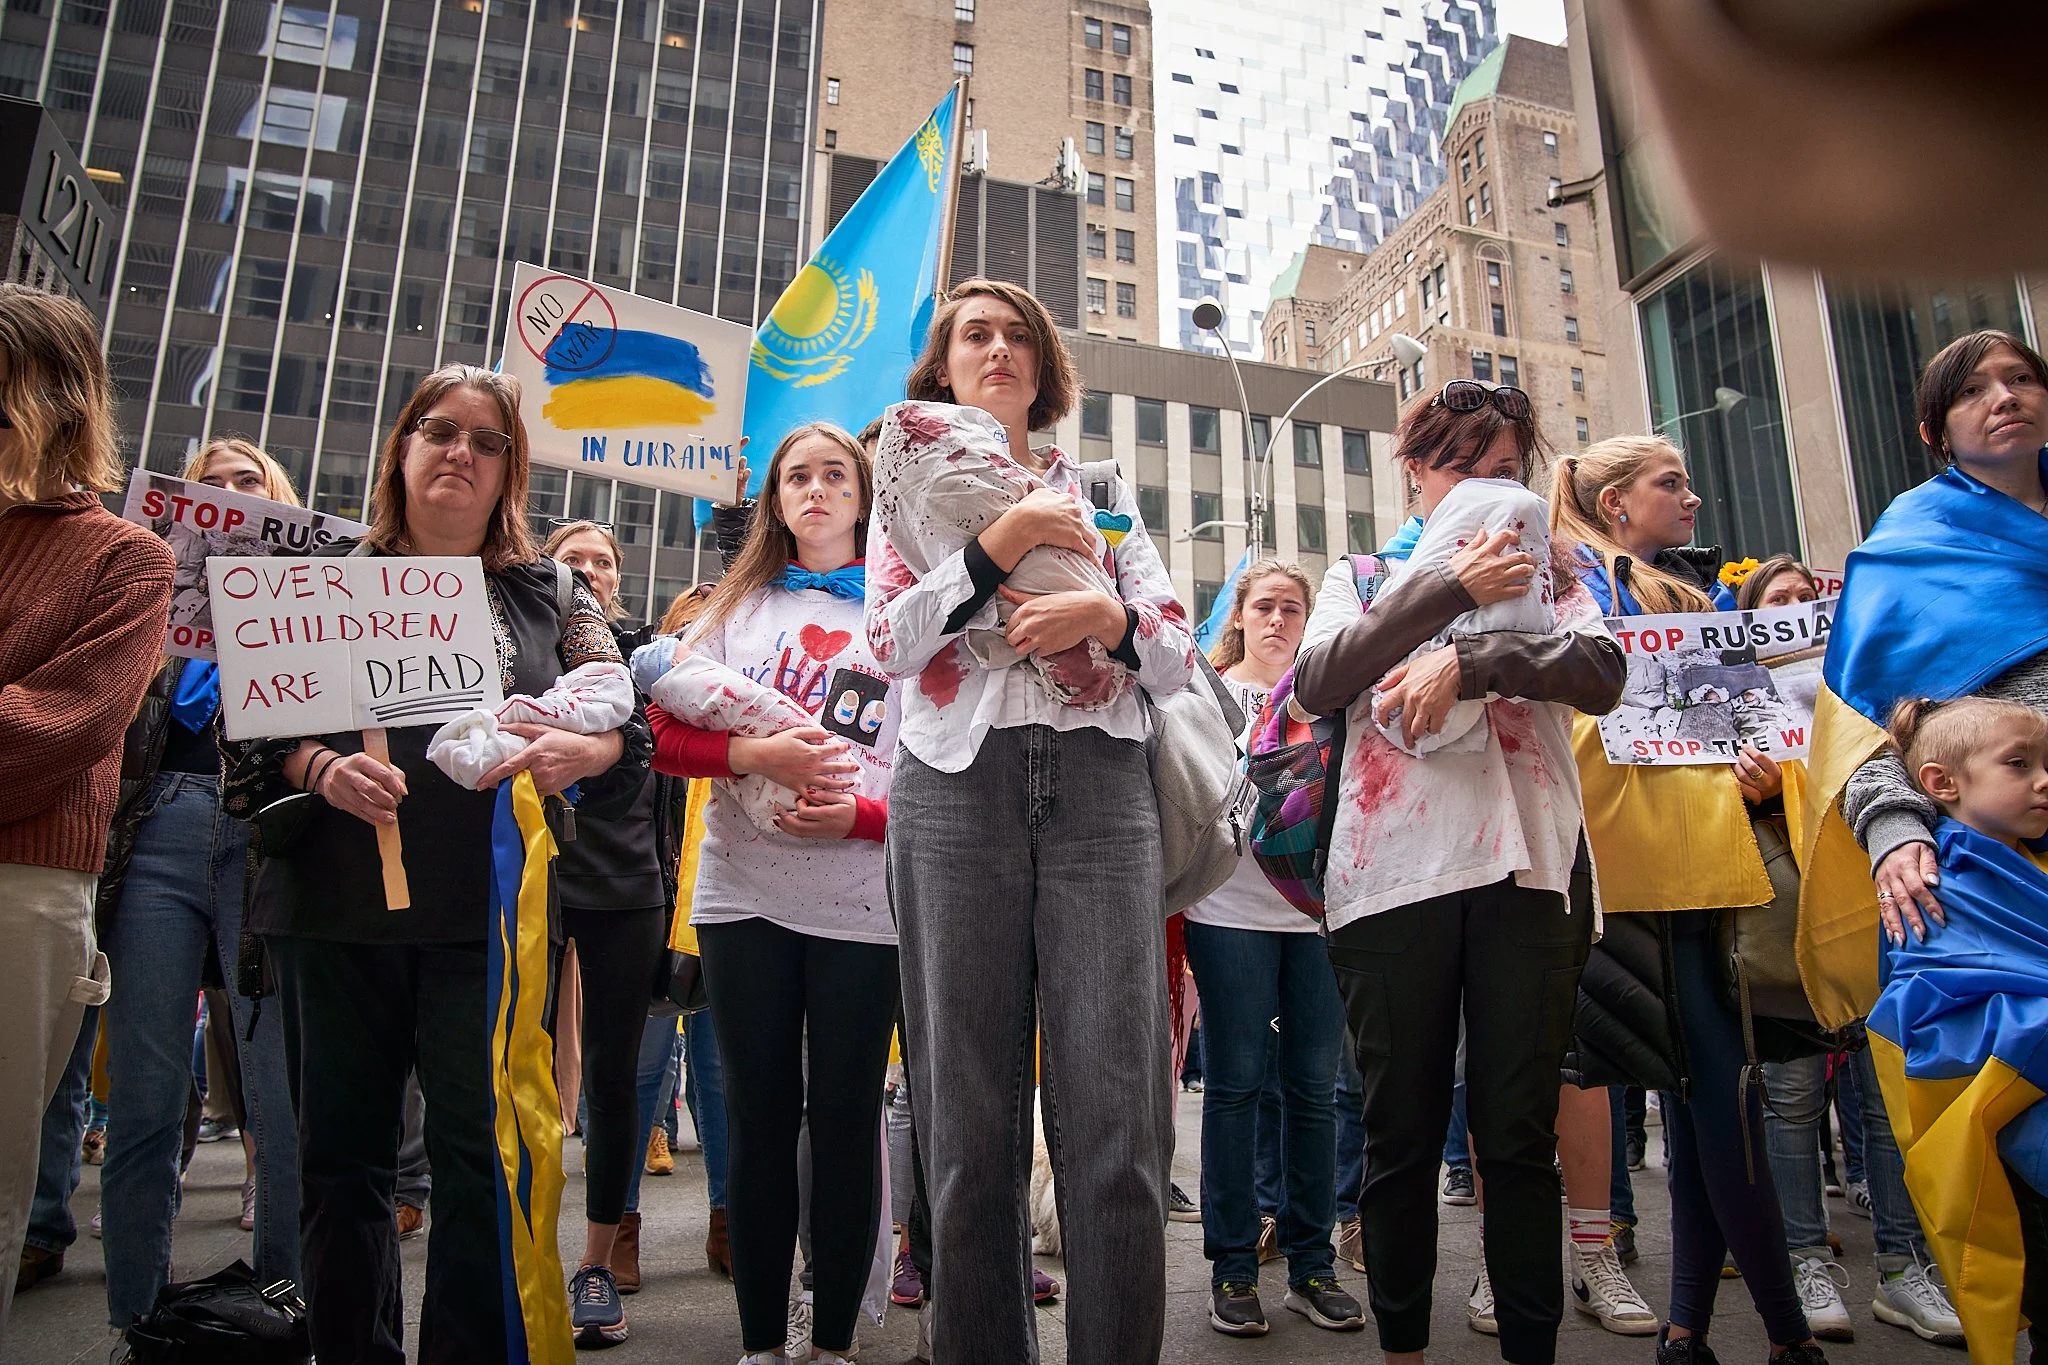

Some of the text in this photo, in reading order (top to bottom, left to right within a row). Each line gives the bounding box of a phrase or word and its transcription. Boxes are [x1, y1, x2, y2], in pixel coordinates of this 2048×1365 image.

[39, 150, 104, 284] 1211
[526, 293, 564, 336] NO
[555, 320, 604, 366] WAR
[582, 436, 607, 462] IN
[141, 490, 351, 551] STOP RUS
[223, 565, 463, 599] OVER 100
[235, 611, 458, 648] CHILDREN
[1616, 628, 1684, 654] TOP
[242, 653, 485, 710] ARE DEAD
[1633, 740, 1701, 757] STOP
[1711, 735, 1770, 757] THE
